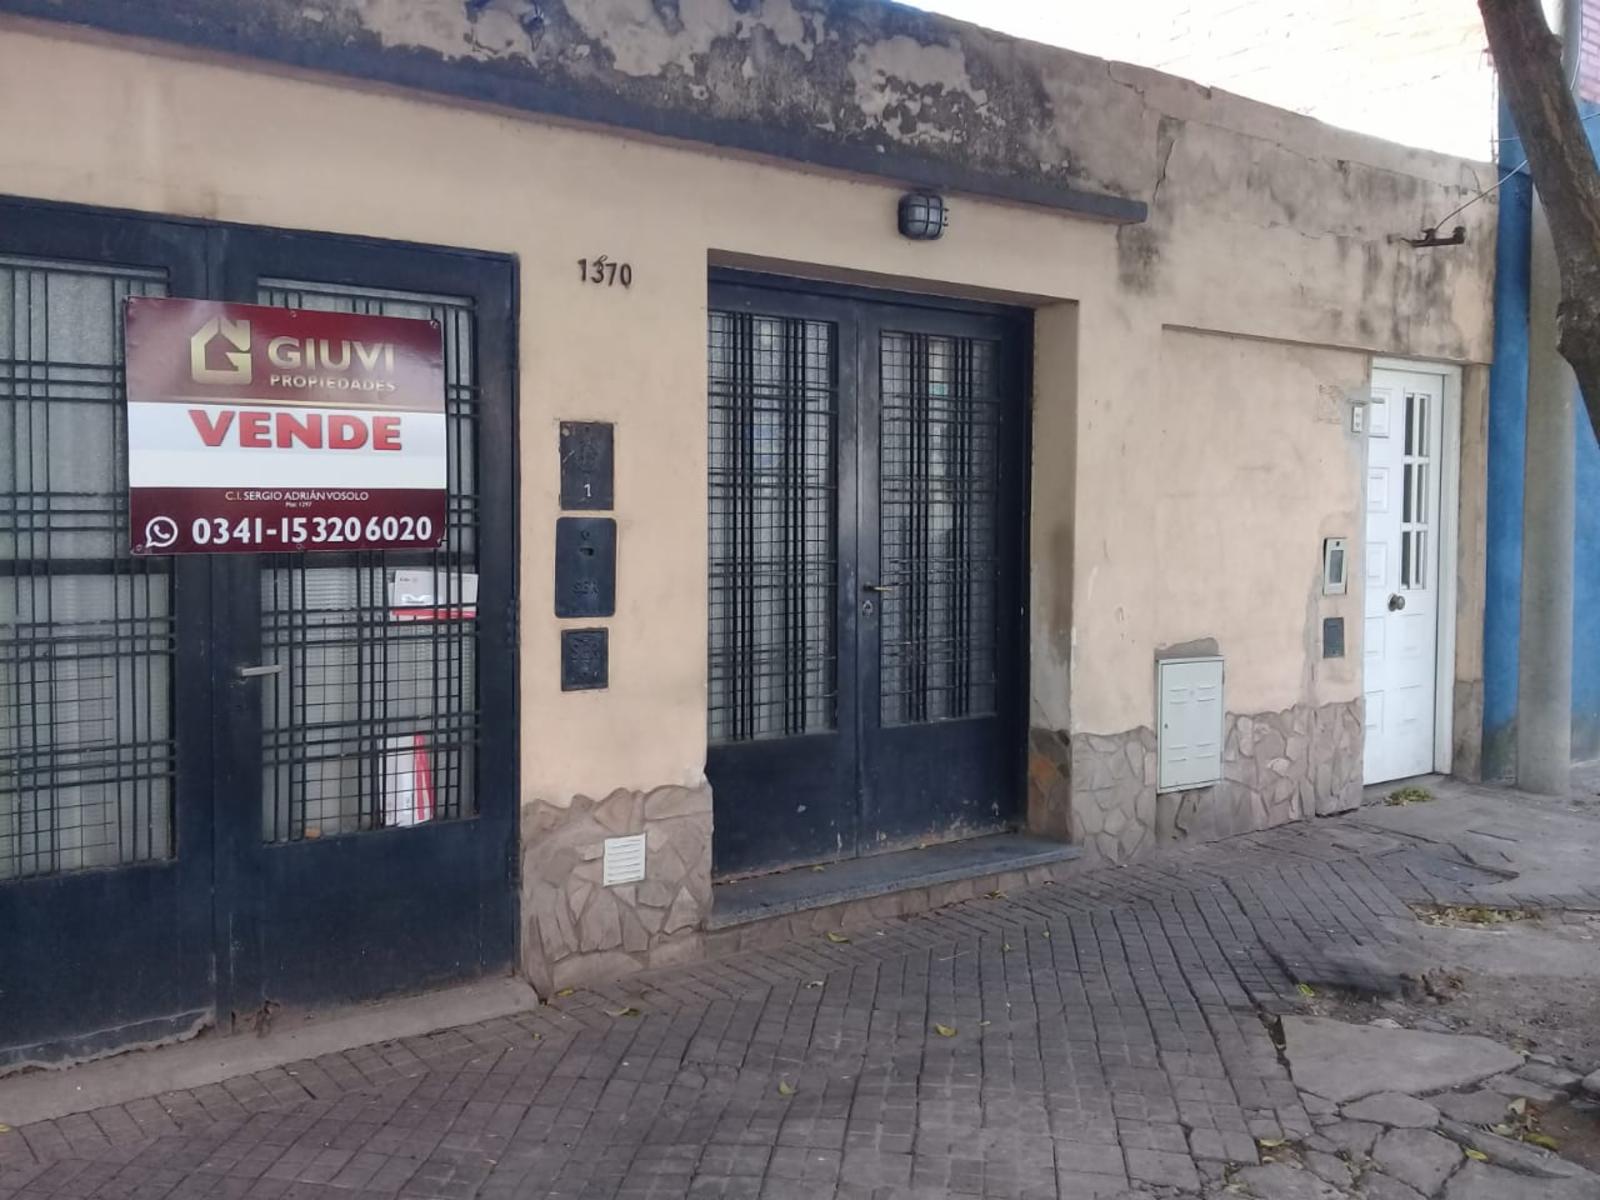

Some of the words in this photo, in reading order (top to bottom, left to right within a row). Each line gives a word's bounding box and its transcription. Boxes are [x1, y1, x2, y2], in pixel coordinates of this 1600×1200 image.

[577, 255, 632, 289] 1370
[267, 335, 395, 372] GIUVI
[270, 374, 397, 392] PROPIEDADES
[188, 409, 402, 451] VENDE
[243, 491, 283, 500] SERGIO
[284, 490, 325, 500] ADRIÁN
[325, 491, 369, 501] VOSOLO
